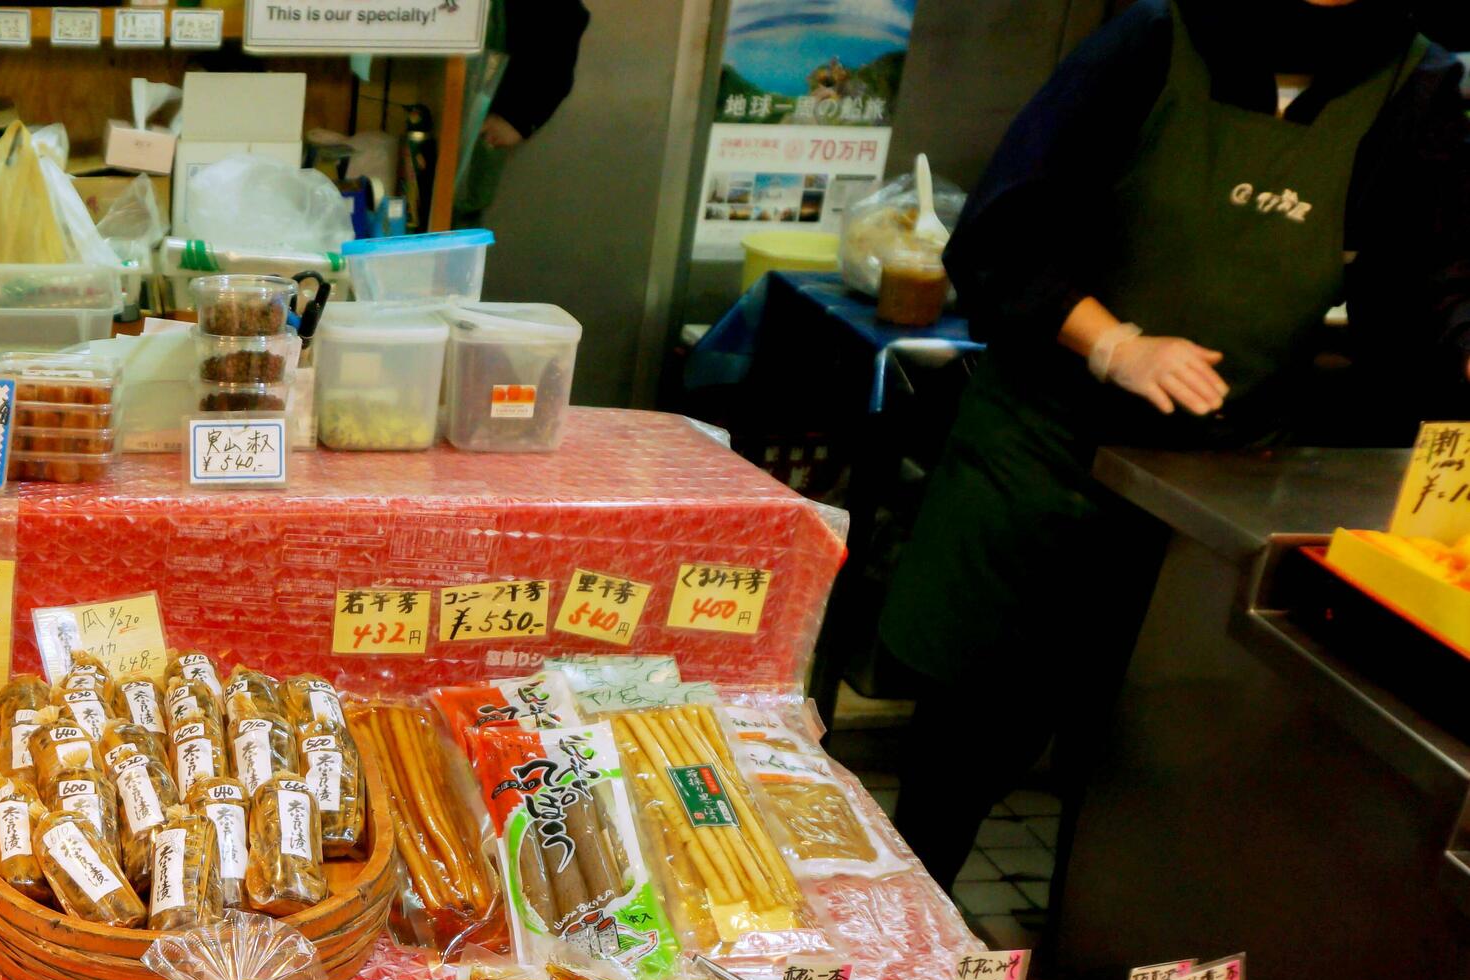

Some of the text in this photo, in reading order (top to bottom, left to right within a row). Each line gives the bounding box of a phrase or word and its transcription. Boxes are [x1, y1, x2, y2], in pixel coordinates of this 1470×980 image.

[267, 6, 436, 26] This is our specialty!
[724, 94, 885, 120] 地球一周の船旅
[808, 139, 878, 161] 70万円
[305, 738, 332, 749] 500
[62, 782, 88, 794] 600
